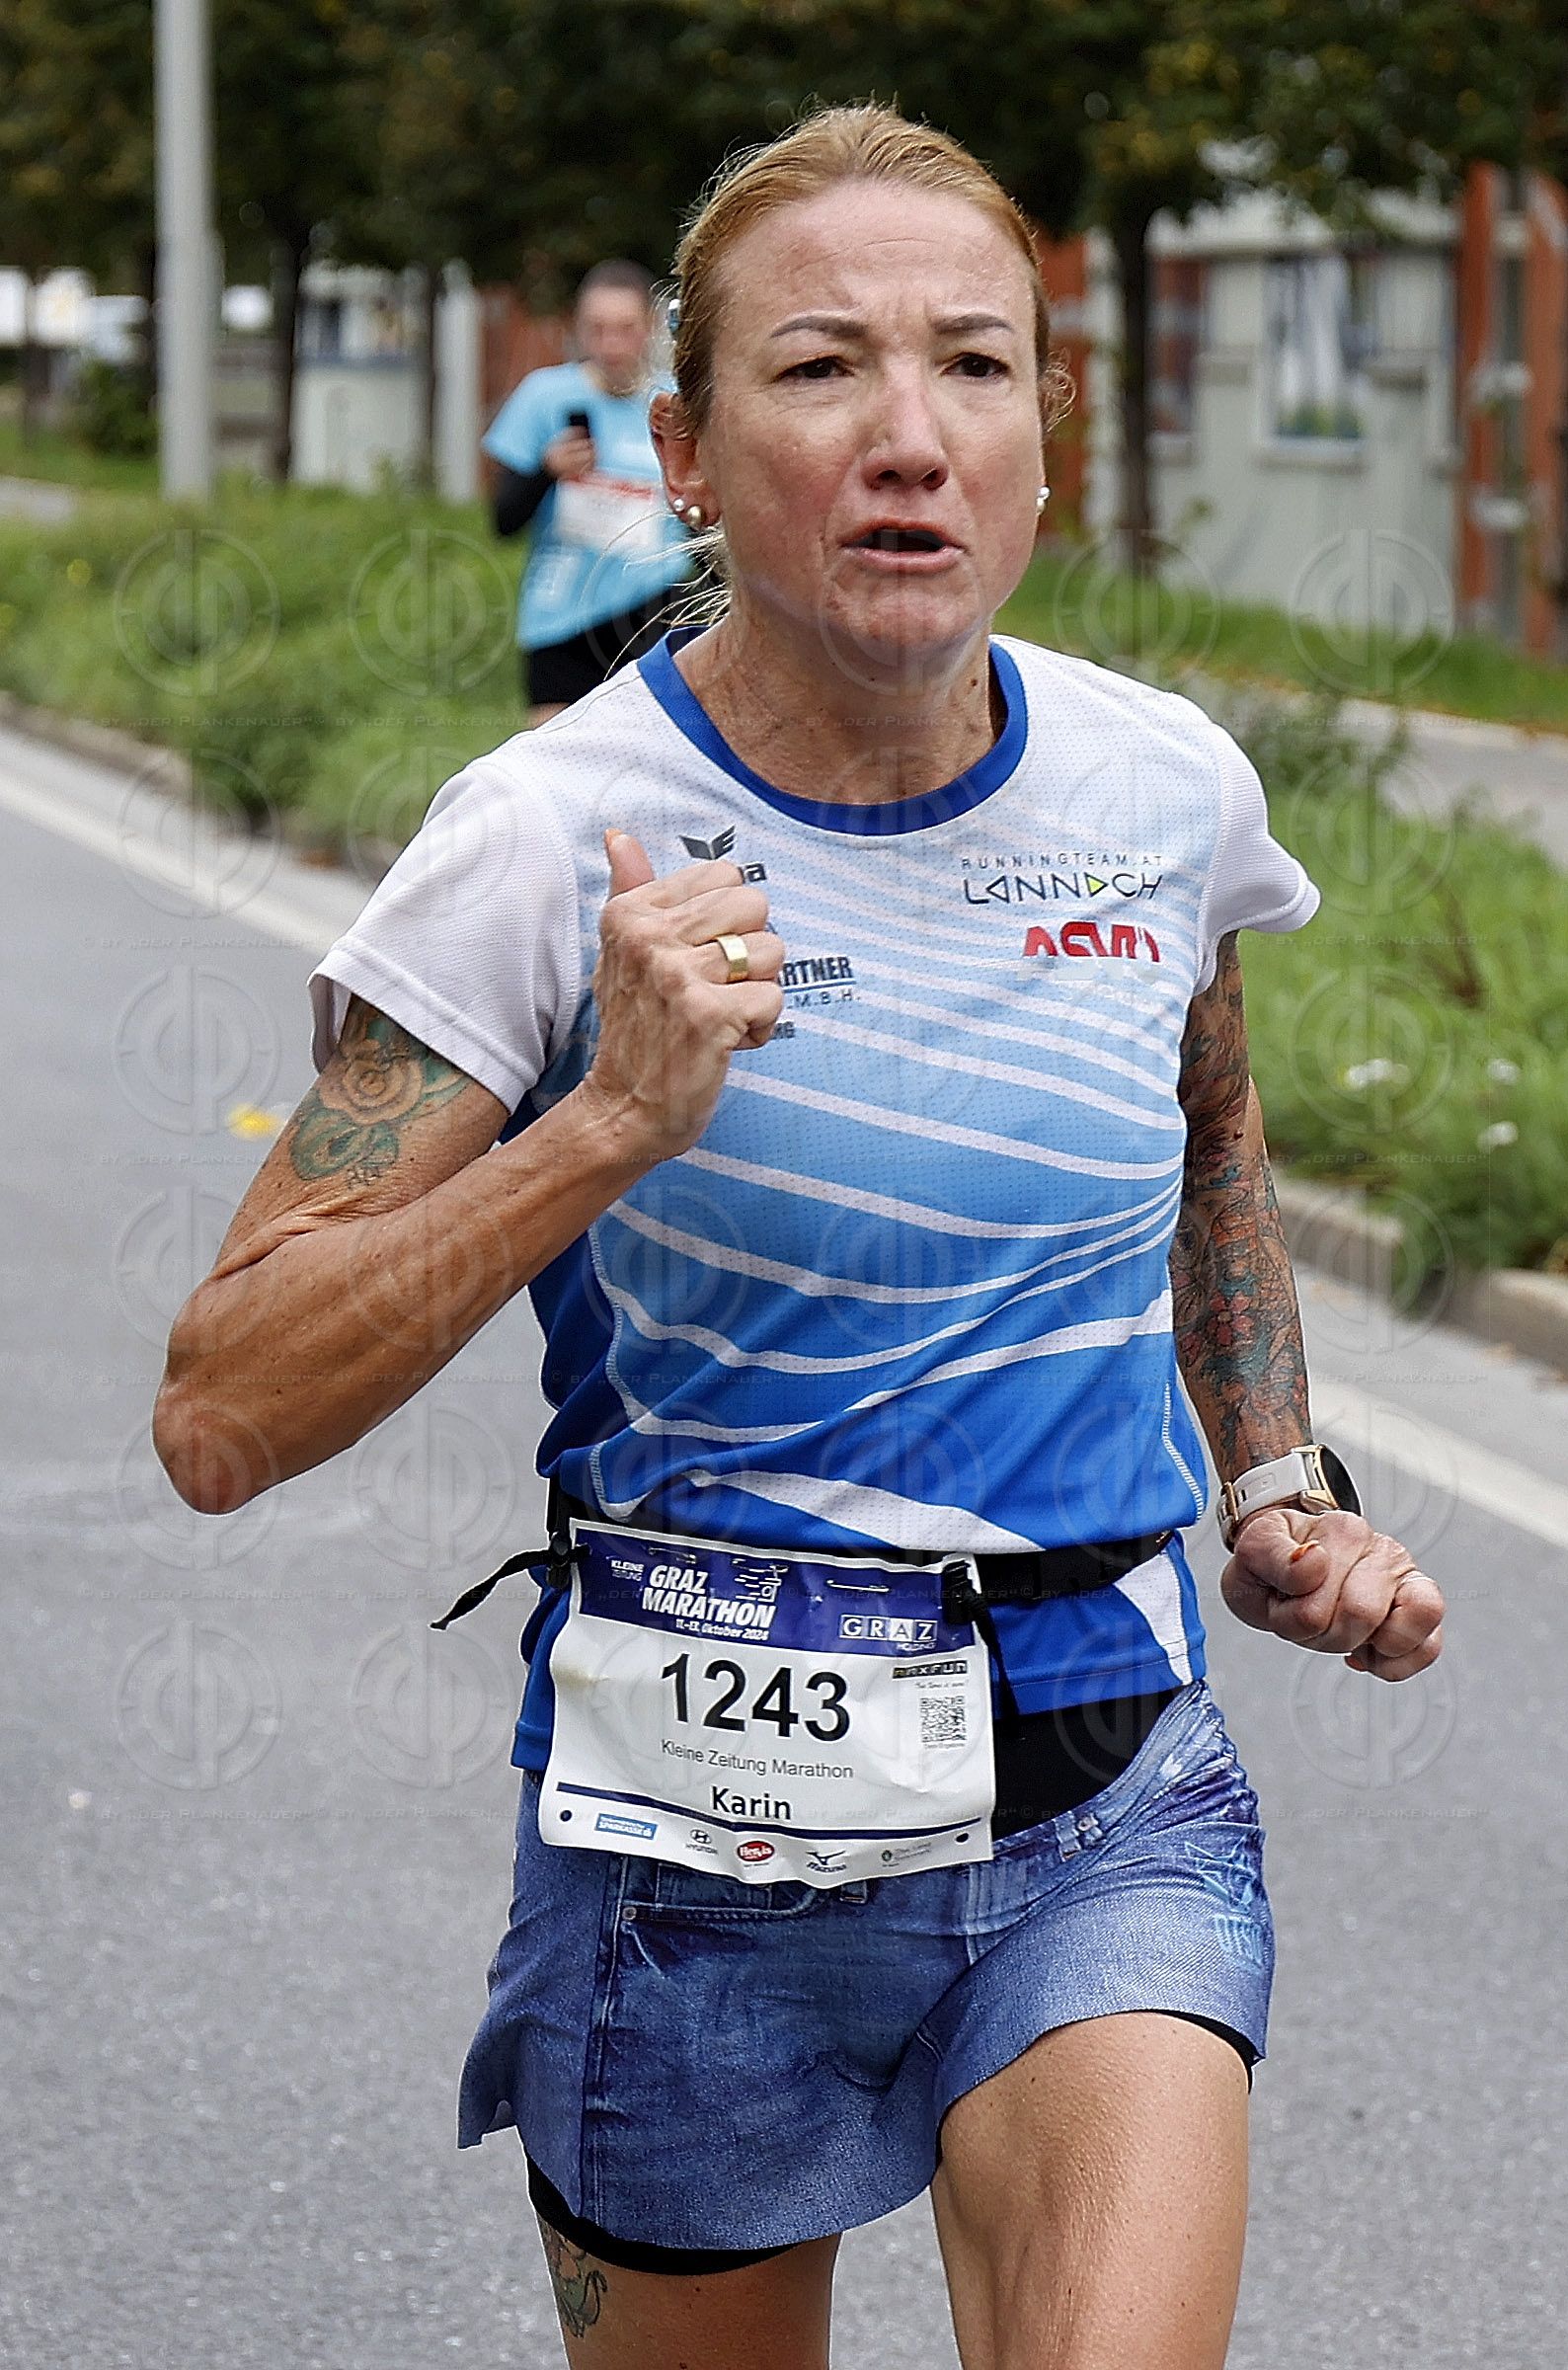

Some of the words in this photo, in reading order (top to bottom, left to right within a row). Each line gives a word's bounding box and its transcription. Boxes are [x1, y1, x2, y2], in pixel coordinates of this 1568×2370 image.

[611, 1559, 644, 1572] KLEINE
[649, 1565, 709, 1594] GRAZ
[642, 1587, 777, 1628] MARATHON
[743, 1627, 769, 1641] 2024
[842, 1617, 934, 1641] GRAZ
[662, 1653, 850, 1742] 1243
[662, 1739, 705, 1763] Kleine
[707, 1749, 766, 1777] Zeitung
[772, 1758, 854, 1778] Marathon
[710, 1785, 792, 1820] Karin
